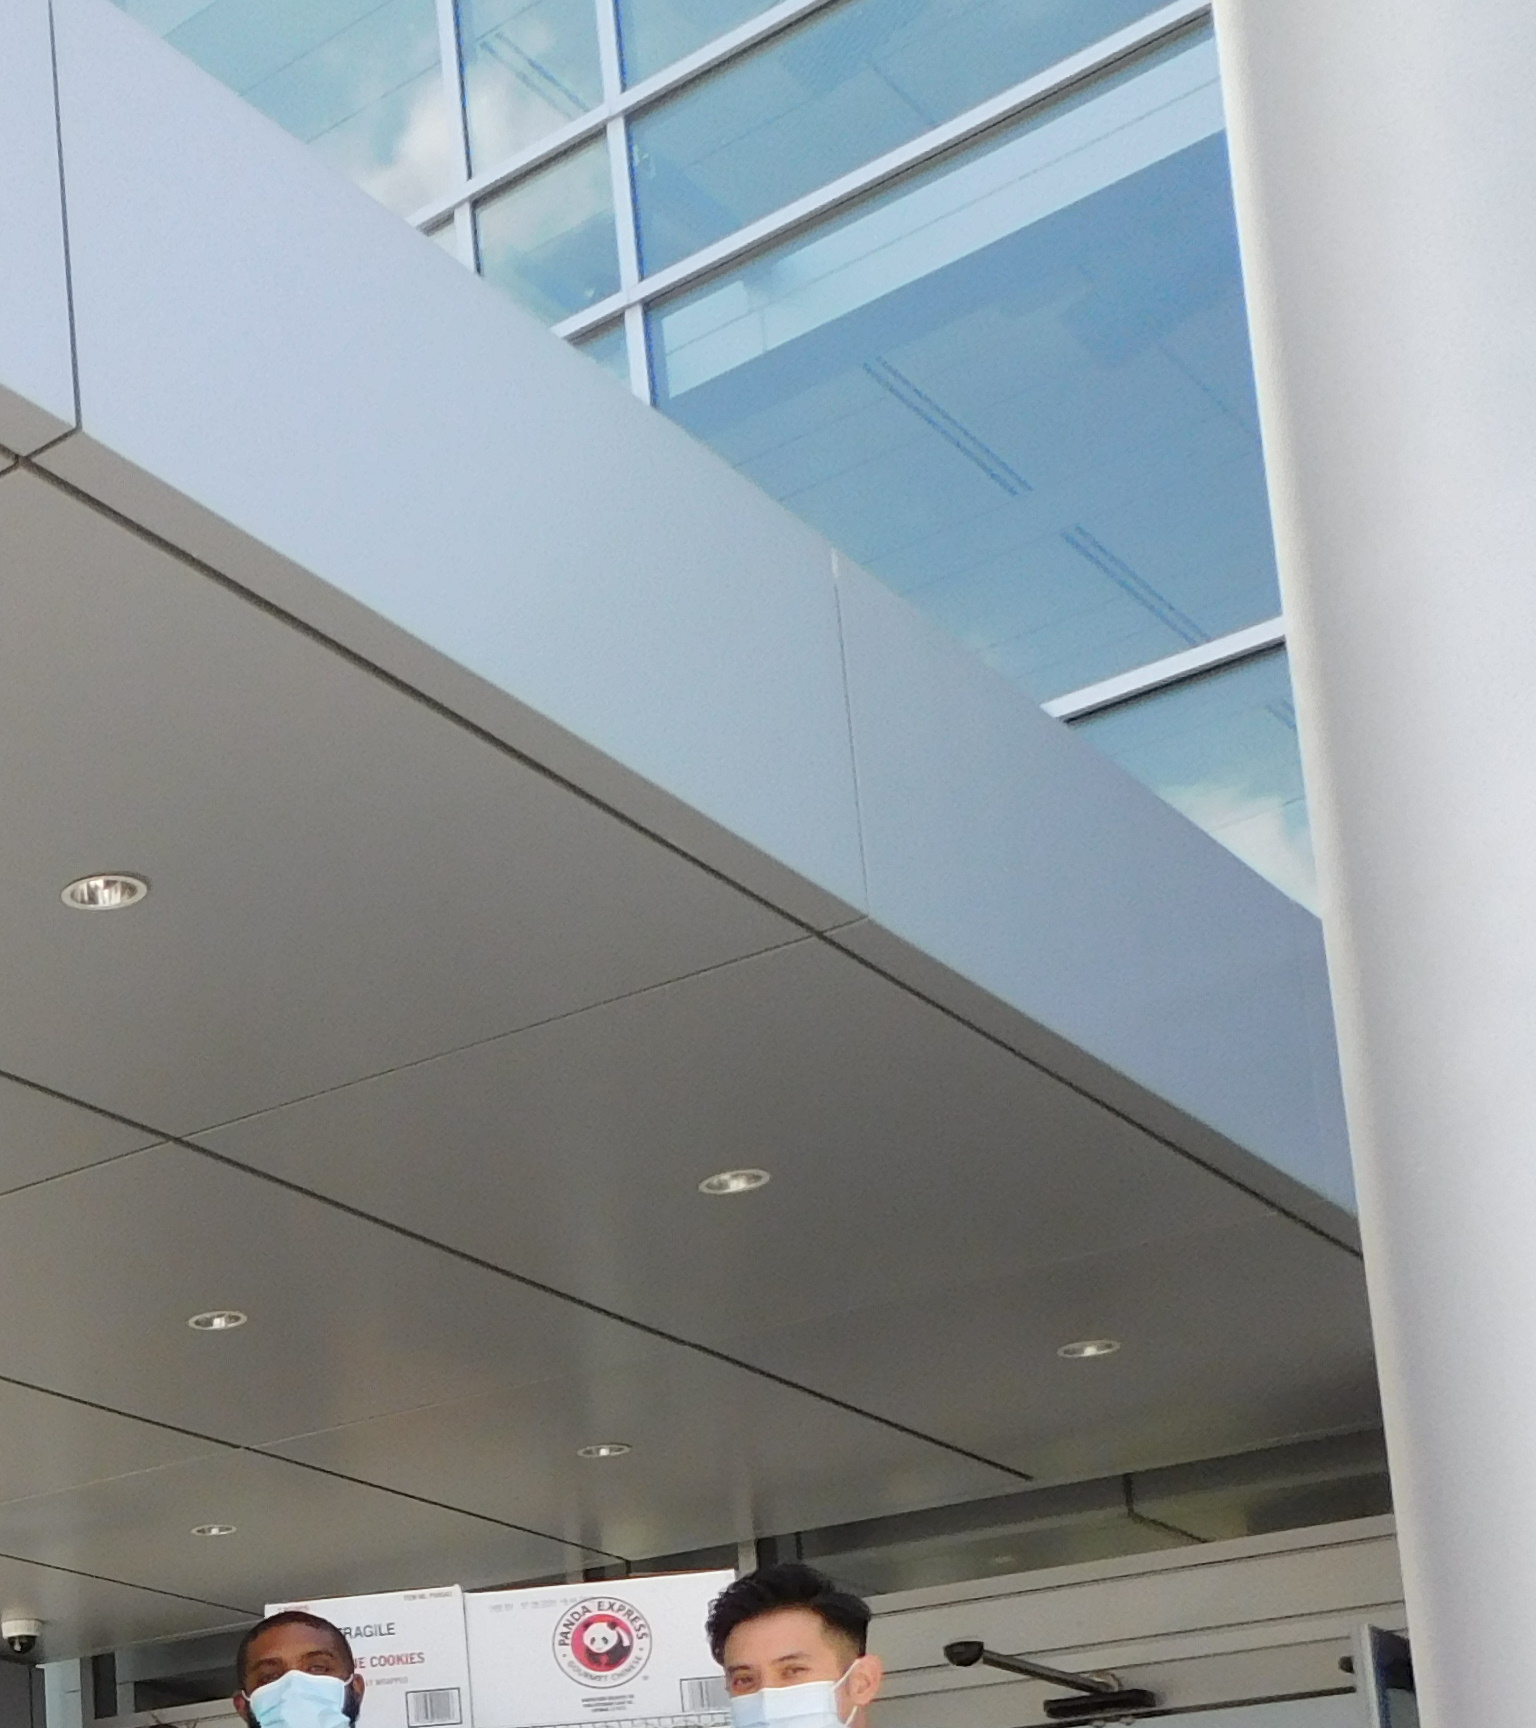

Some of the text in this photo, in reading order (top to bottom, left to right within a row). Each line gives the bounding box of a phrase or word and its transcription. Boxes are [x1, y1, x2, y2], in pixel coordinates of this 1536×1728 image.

[558, 1600, 649, 1647] PANDA EXPRESS
[370, 1652, 426, 1668] COOKIES
